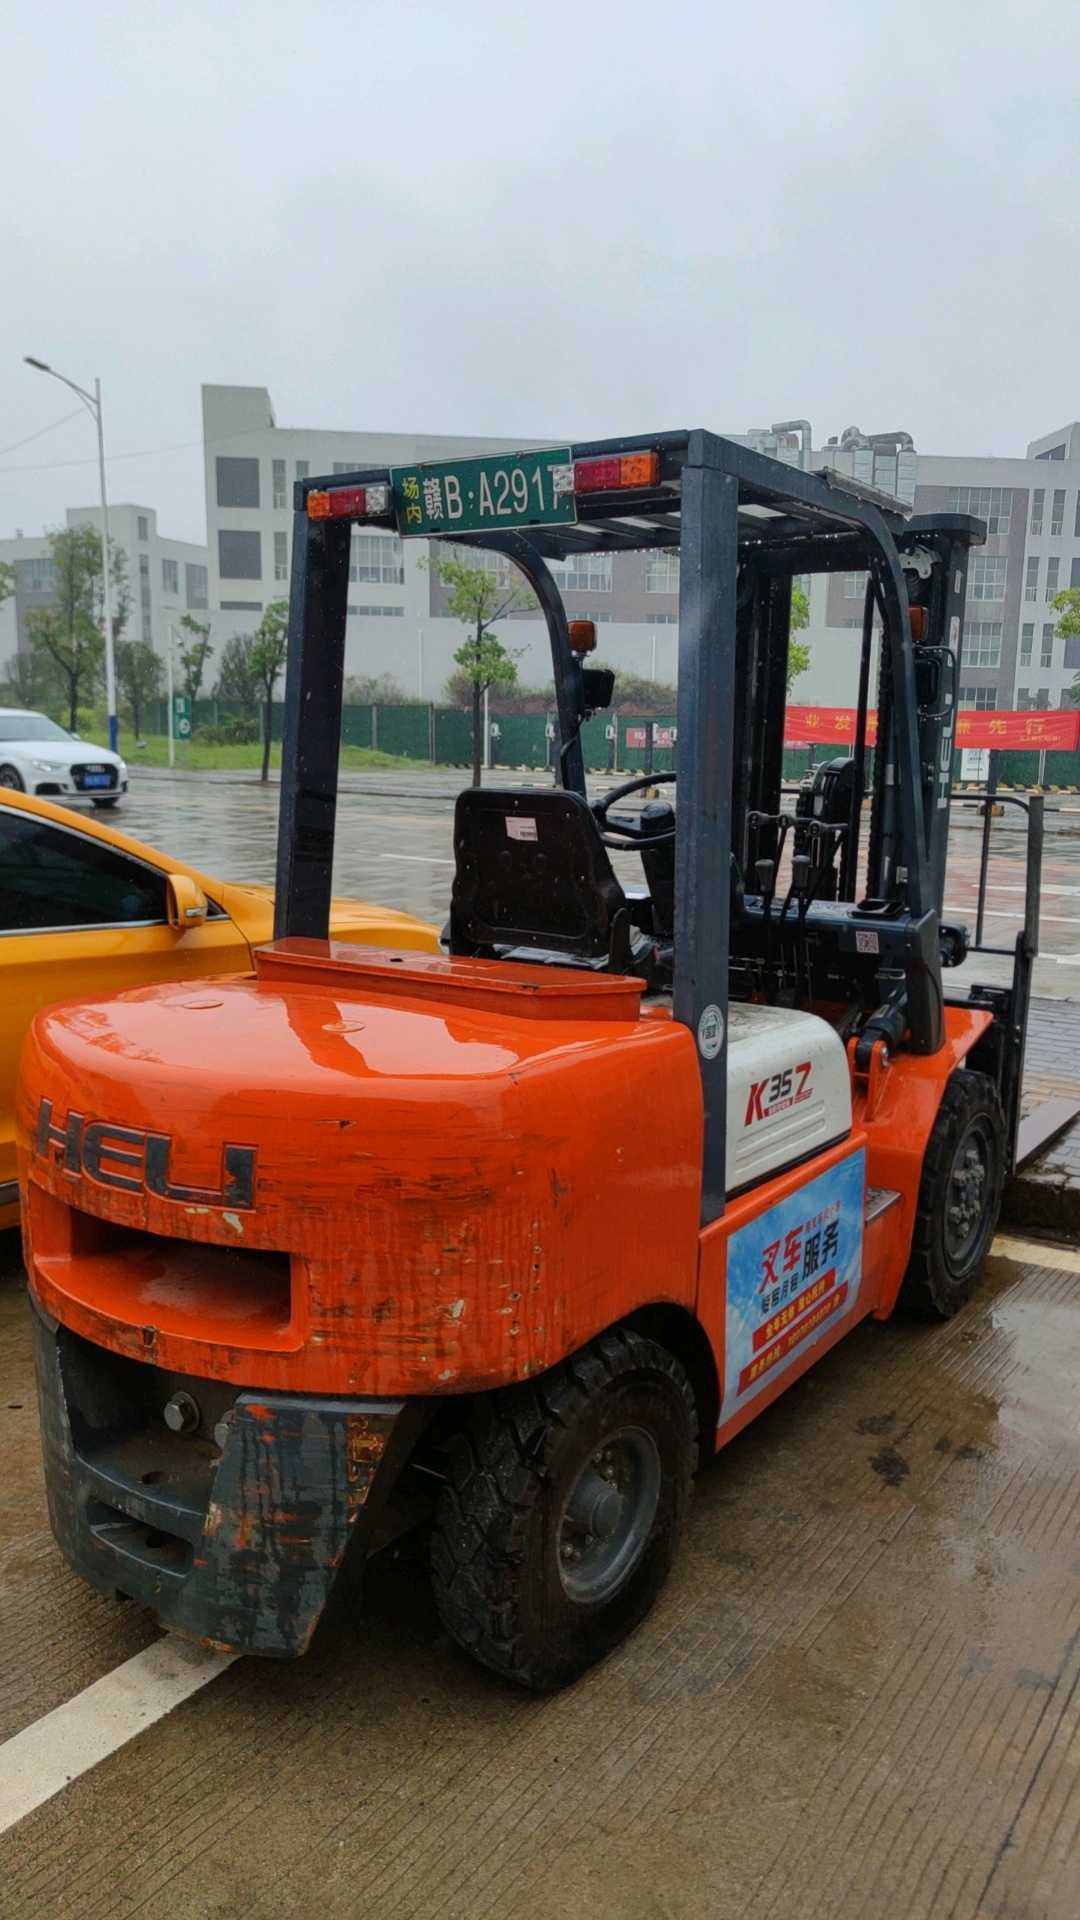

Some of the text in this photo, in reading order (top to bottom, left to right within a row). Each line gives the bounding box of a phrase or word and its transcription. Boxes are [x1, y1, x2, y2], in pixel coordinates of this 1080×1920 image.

[401, 476, 423, 524] 场内
[38, 1097, 257, 1213] HELI
[758, 1219, 840, 1294] 叉车服务
